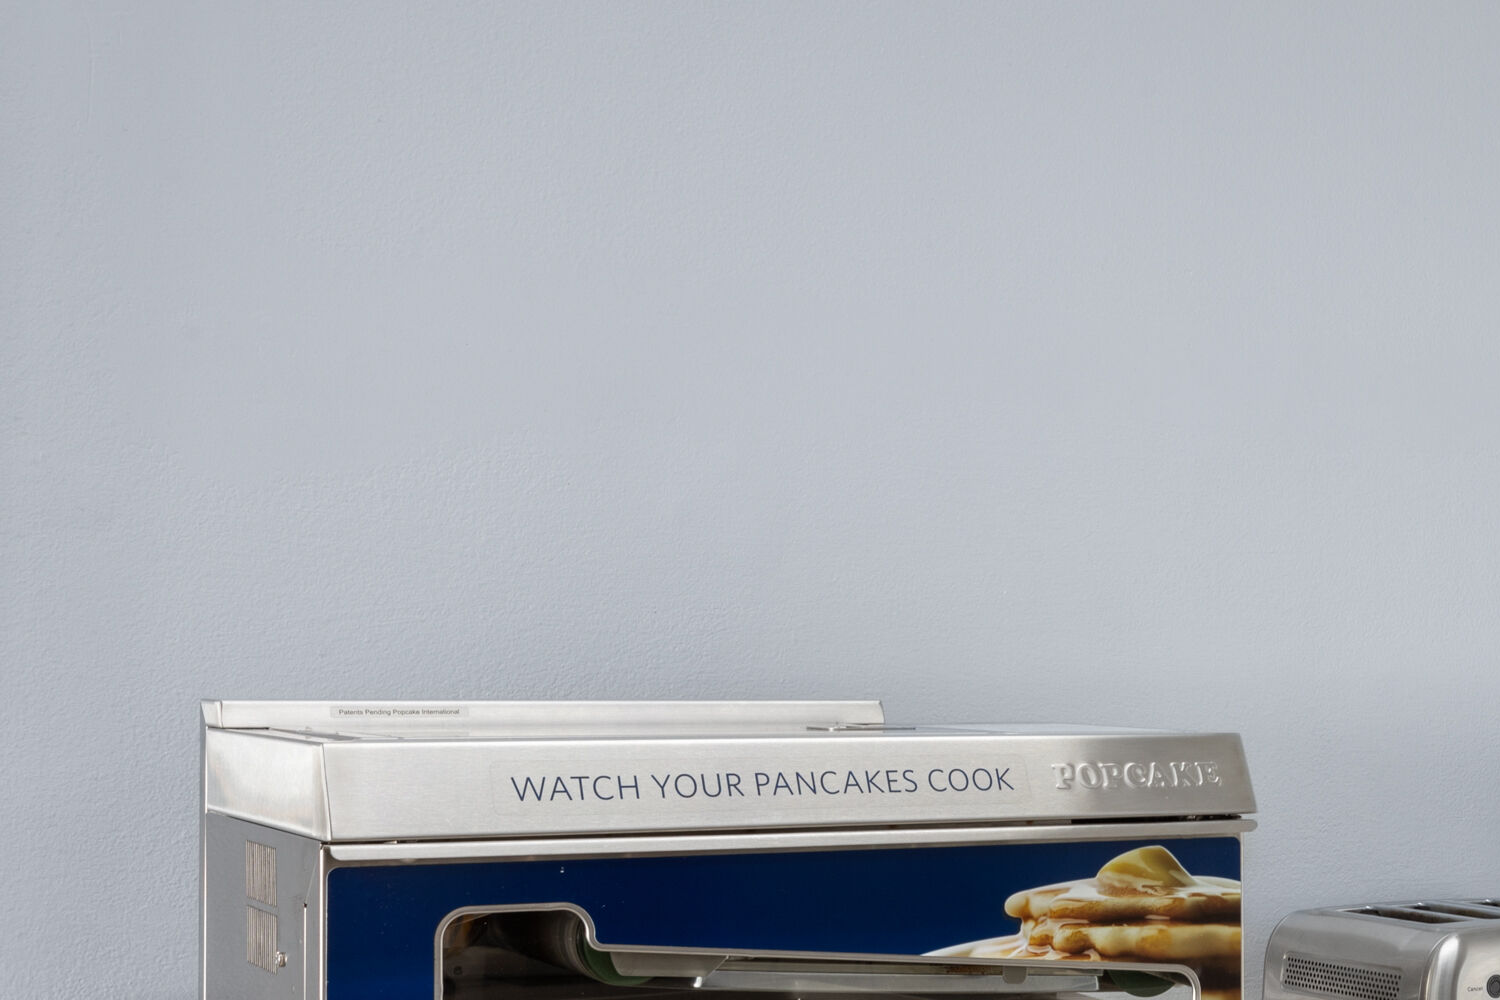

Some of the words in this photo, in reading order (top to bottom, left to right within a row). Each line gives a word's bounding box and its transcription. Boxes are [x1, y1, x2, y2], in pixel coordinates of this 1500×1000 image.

[338, 708, 363, 716] Patents
[365, 708, 391, 717] Pending
[393, 708, 420, 717] Popcake
[421, 708, 460, 716] International
[510, 774, 641, 802] WATCH
[650, 772, 745, 799] YOUR
[754, 769, 919, 796] PANCAKES
[927, 767, 1015, 793] COOK
[1051, 761, 1222, 790] POPCAKE
